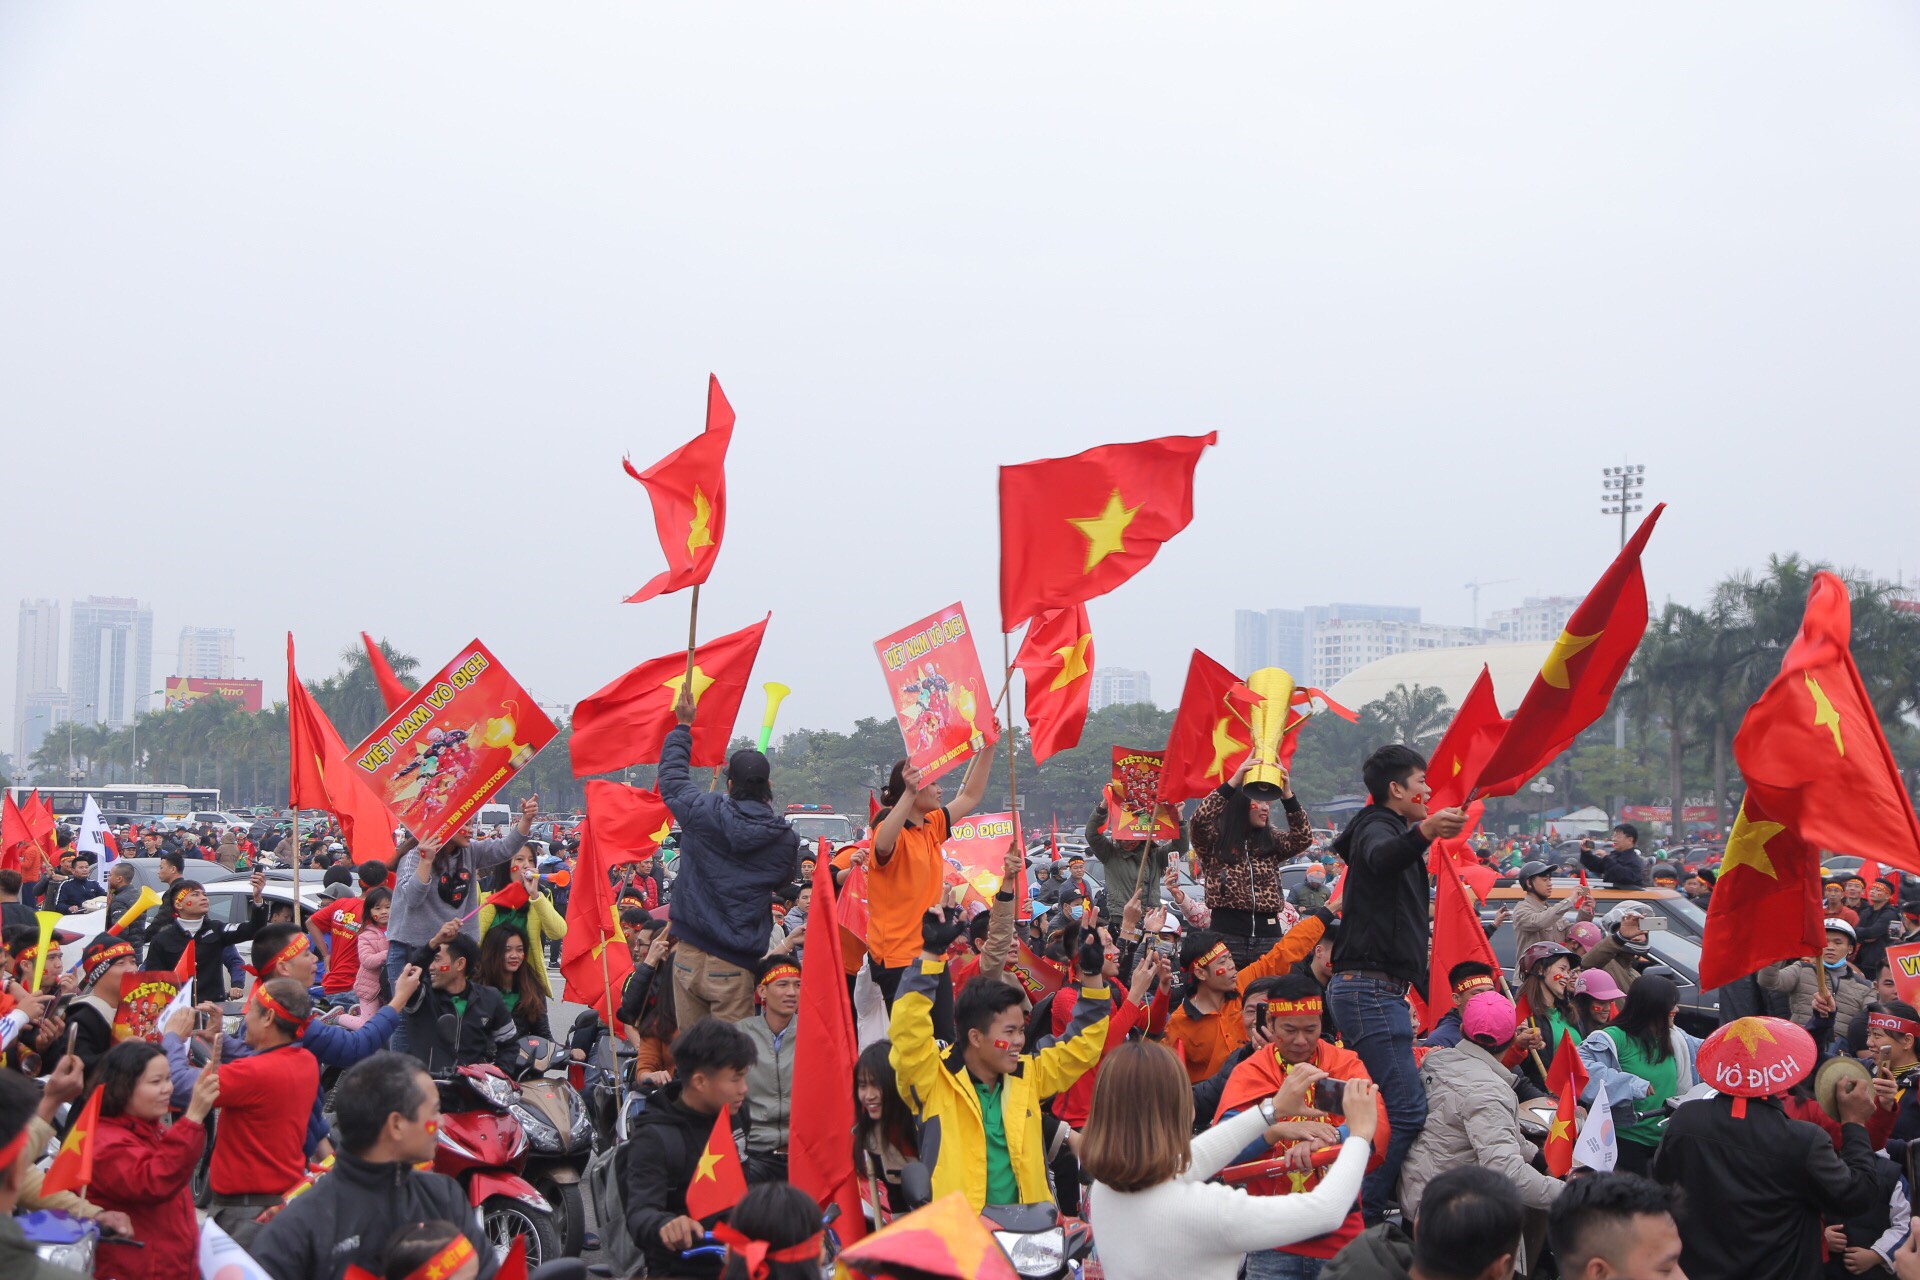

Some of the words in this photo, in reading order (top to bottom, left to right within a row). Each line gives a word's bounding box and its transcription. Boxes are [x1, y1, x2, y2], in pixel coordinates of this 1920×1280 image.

[884, 642, 906, 670] VIỆT
[906, 633, 931, 660] NAM
[942, 615, 966, 641] ĐỊCH
[358, 736, 396, 773] VIỆT
[391, 705, 434, 745] NAM
[427, 682, 455, 710] VÔ
[451, 652, 489, 690] ĐỊCH
[946, 740, 969, 761] BOOKSTORE
[1116, 754, 1142, 767] VIỆT
[447, 810, 463, 825] TIEN
[460, 798, 475, 812] THO
[472, 766, 508, 801] BOOKSTORE
[952, 823, 975, 840] VÔ
[978, 821, 1013, 839] ĐỊCH
[284, 945, 299, 957] VIỆT
[123, 981, 159, 1003] VIỆT
[160, 981, 178, 997] NA
[1276, 1001, 1293, 1012] NAM
[1306, 999, 1317, 1011] VÔ
[1716, 1062, 1743, 1087] VÔ
[1747, 1054, 1801, 1092] ĐỊCH
